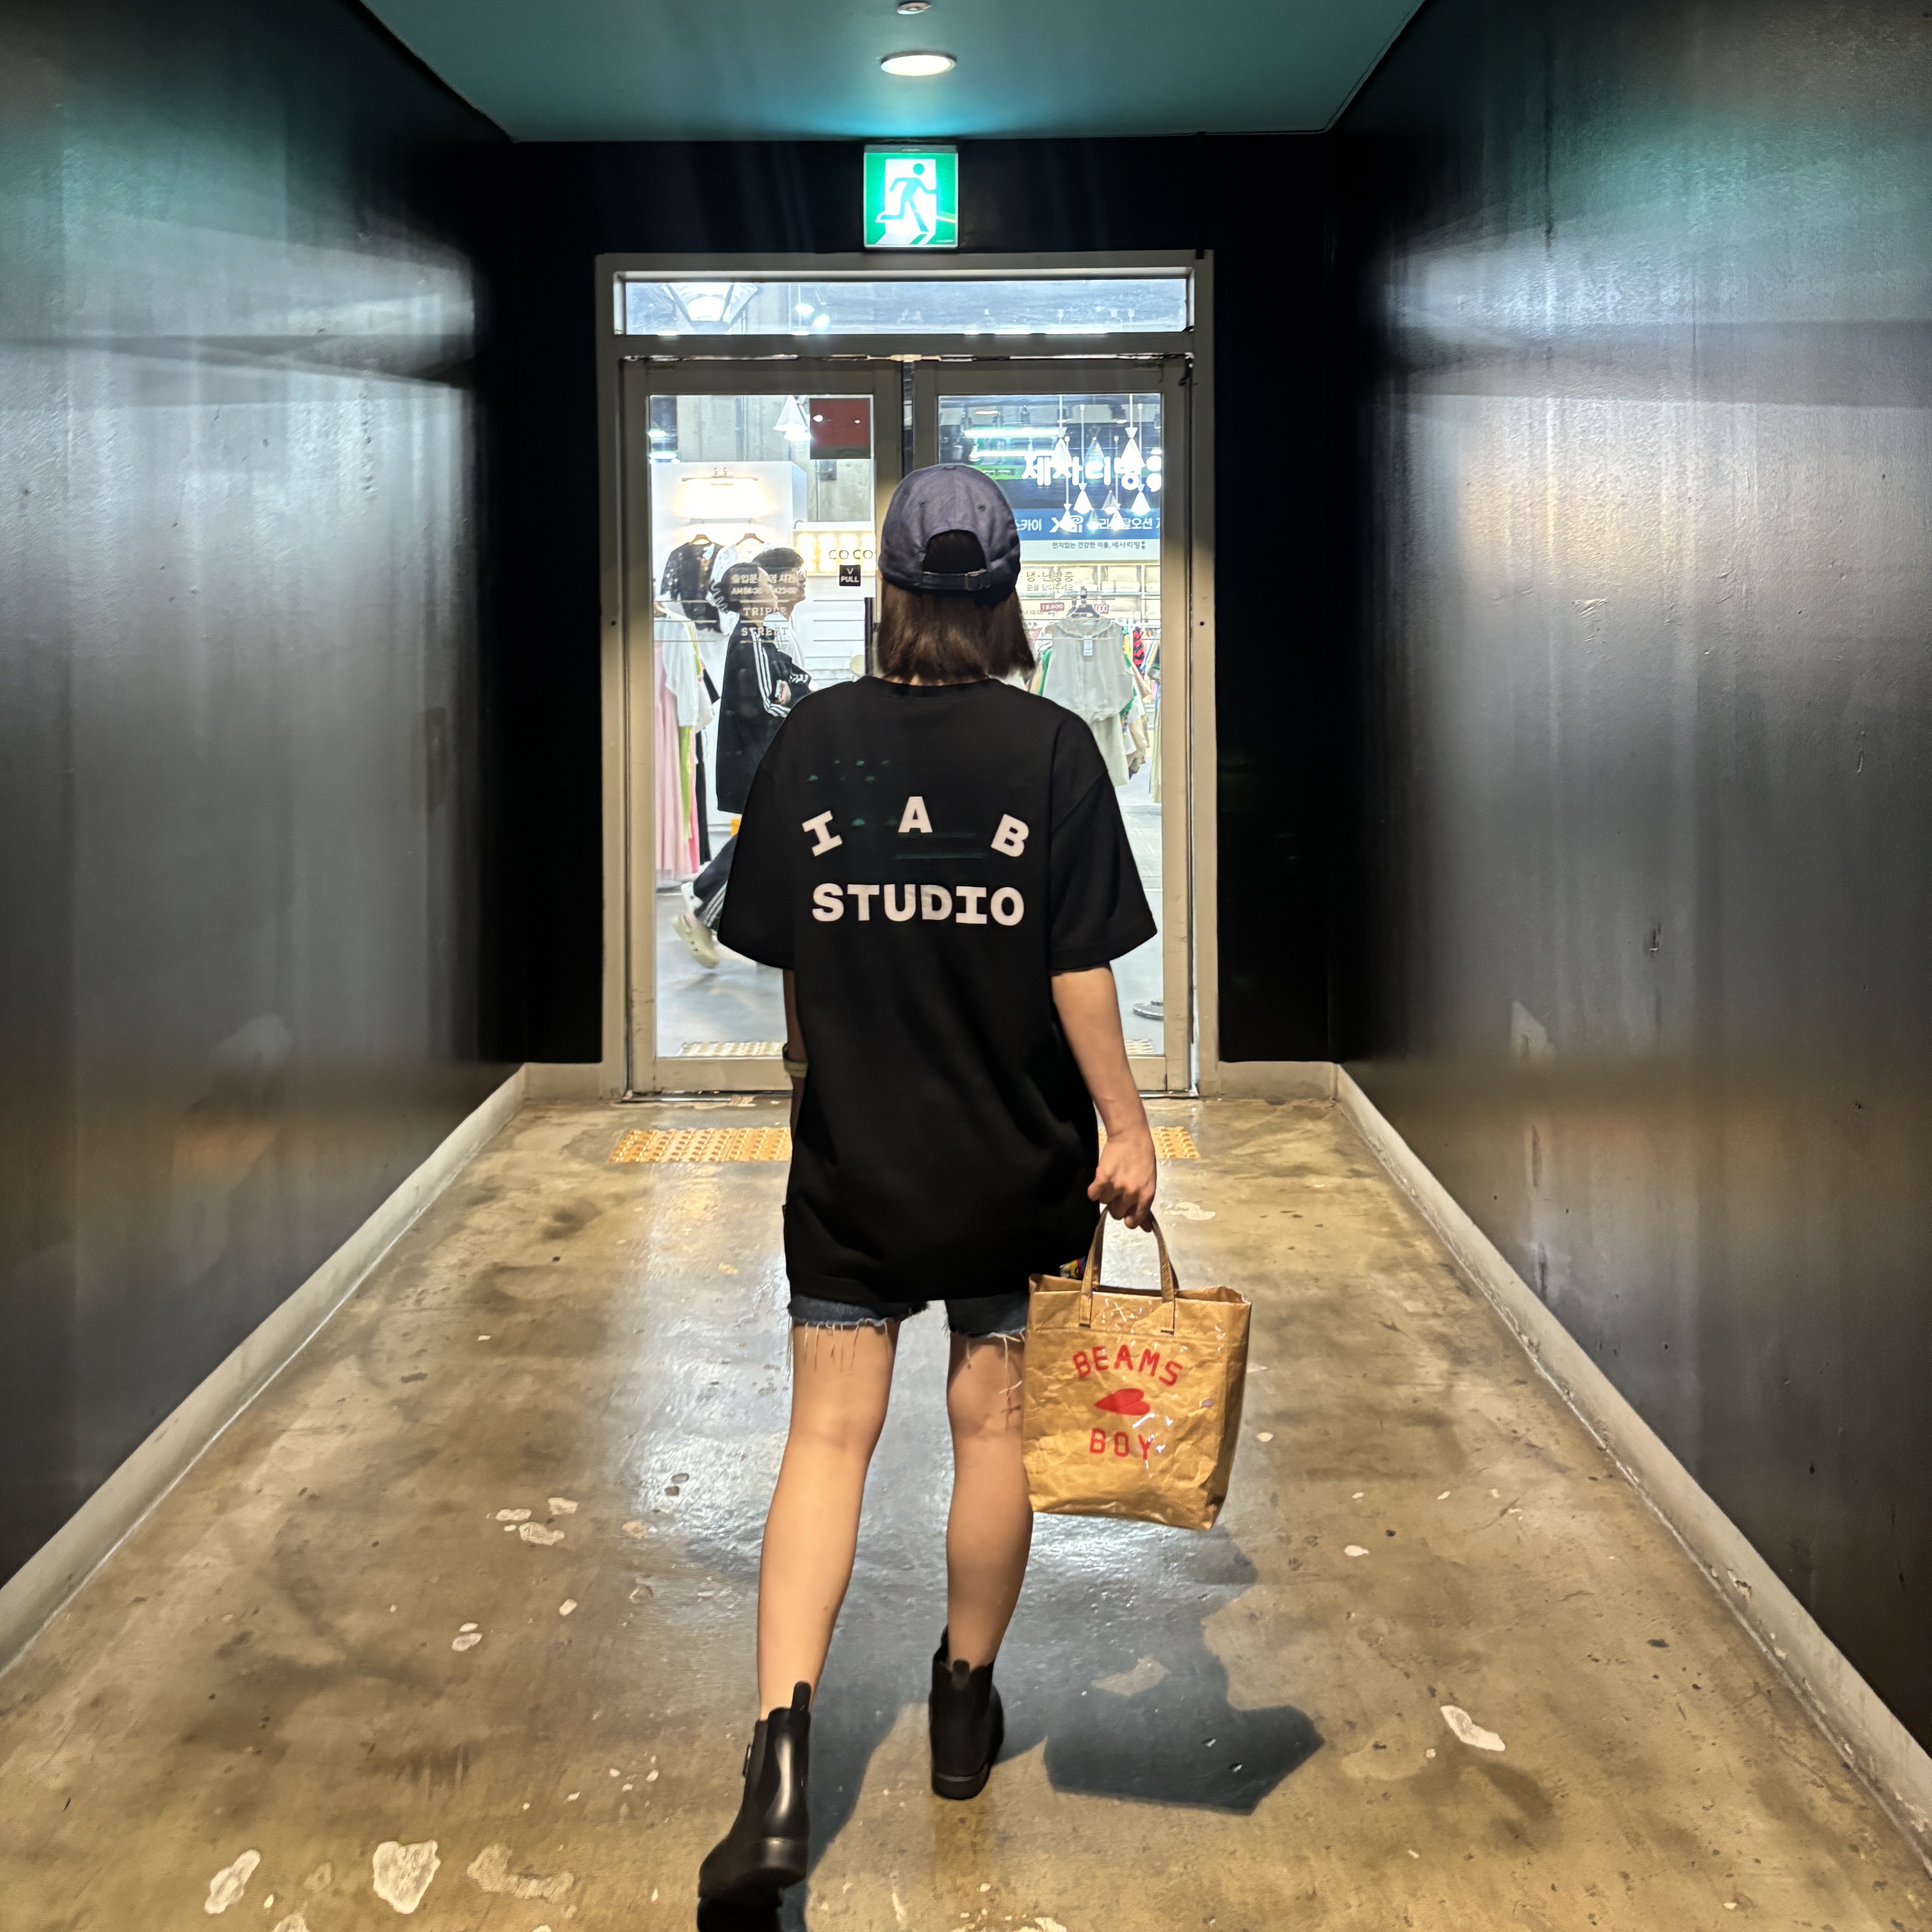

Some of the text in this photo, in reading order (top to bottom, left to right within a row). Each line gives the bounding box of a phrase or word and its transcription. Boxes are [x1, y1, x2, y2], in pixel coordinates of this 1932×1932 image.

[812, 883, 1024, 926] STUDIO
[1072, 1344, 1183, 1386] BEAMS
[1089, 1428, 1154, 1461] BOY
